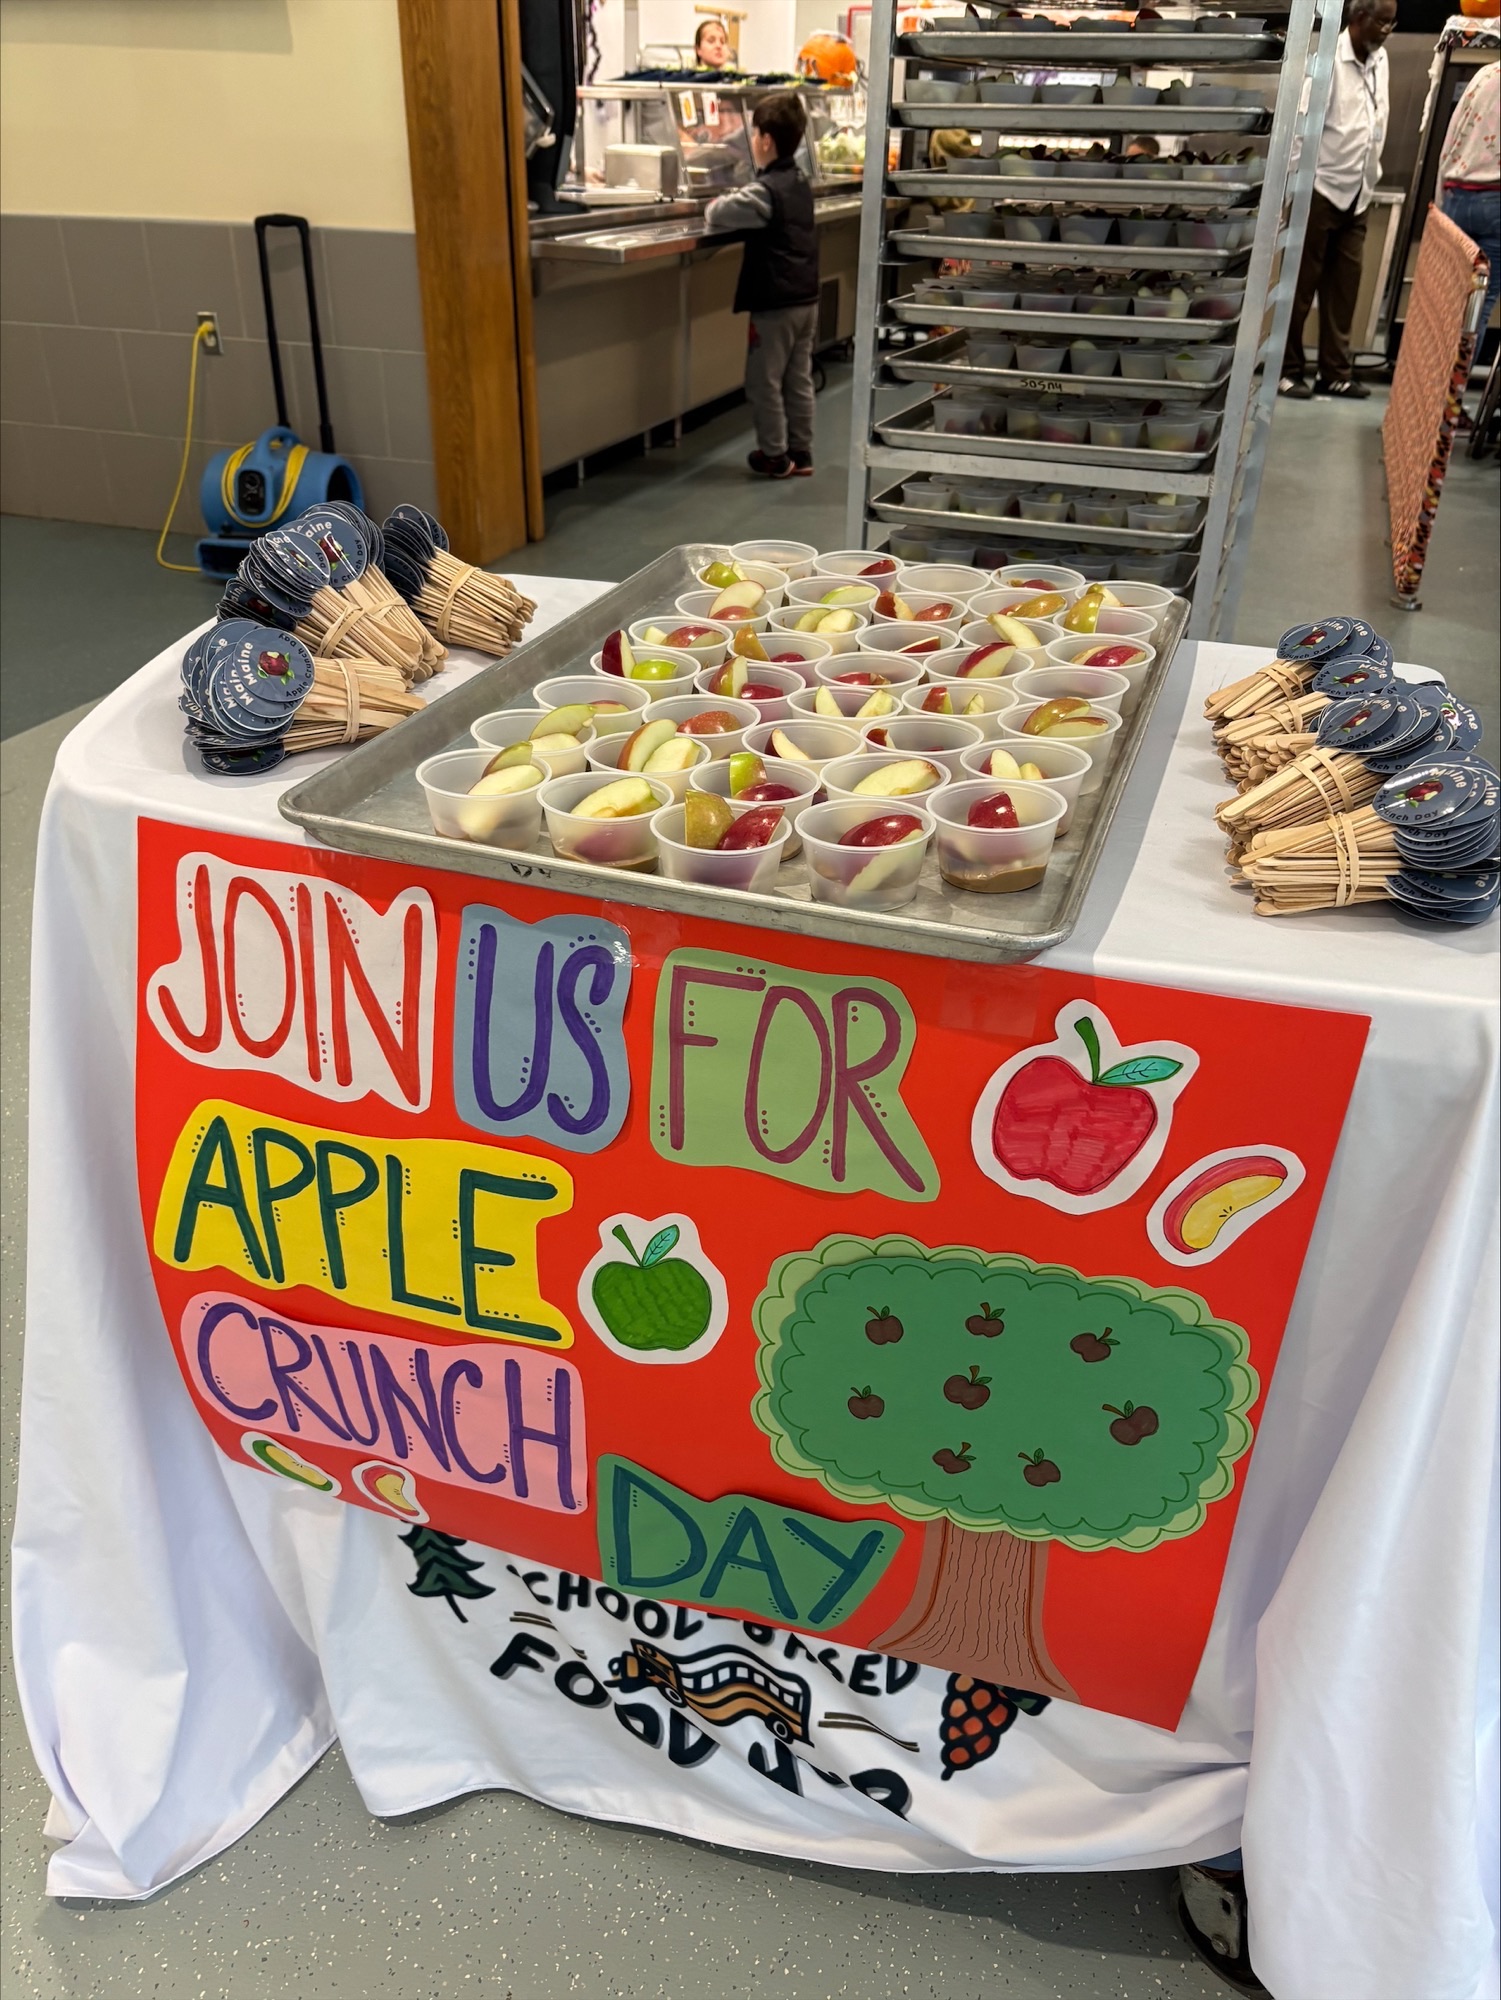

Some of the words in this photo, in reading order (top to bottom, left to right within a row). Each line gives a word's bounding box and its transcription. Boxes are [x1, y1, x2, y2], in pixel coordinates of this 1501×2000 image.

[305, 521, 332, 538] aine
[278, 633, 297, 647] Day
[237, 642, 257, 686] Maine
[298, 647, 312, 679] Crunch
[229, 669, 254, 706] Main
[285, 681, 309, 697] Apple
[1447, 693, 1479, 730] Maine
[1414, 809, 1438, 820] Day
[158, 864, 424, 1107] JOIN
[473, 924, 616, 1135] US
[669, 965, 926, 1193] FOR
[173, 1115, 562, 1341] APPLE
[197, 1301, 577, 1510] CRUNCH
[612, 1464, 884, 1624] DAY
[490, 1632, 720, 1768] FOOD
